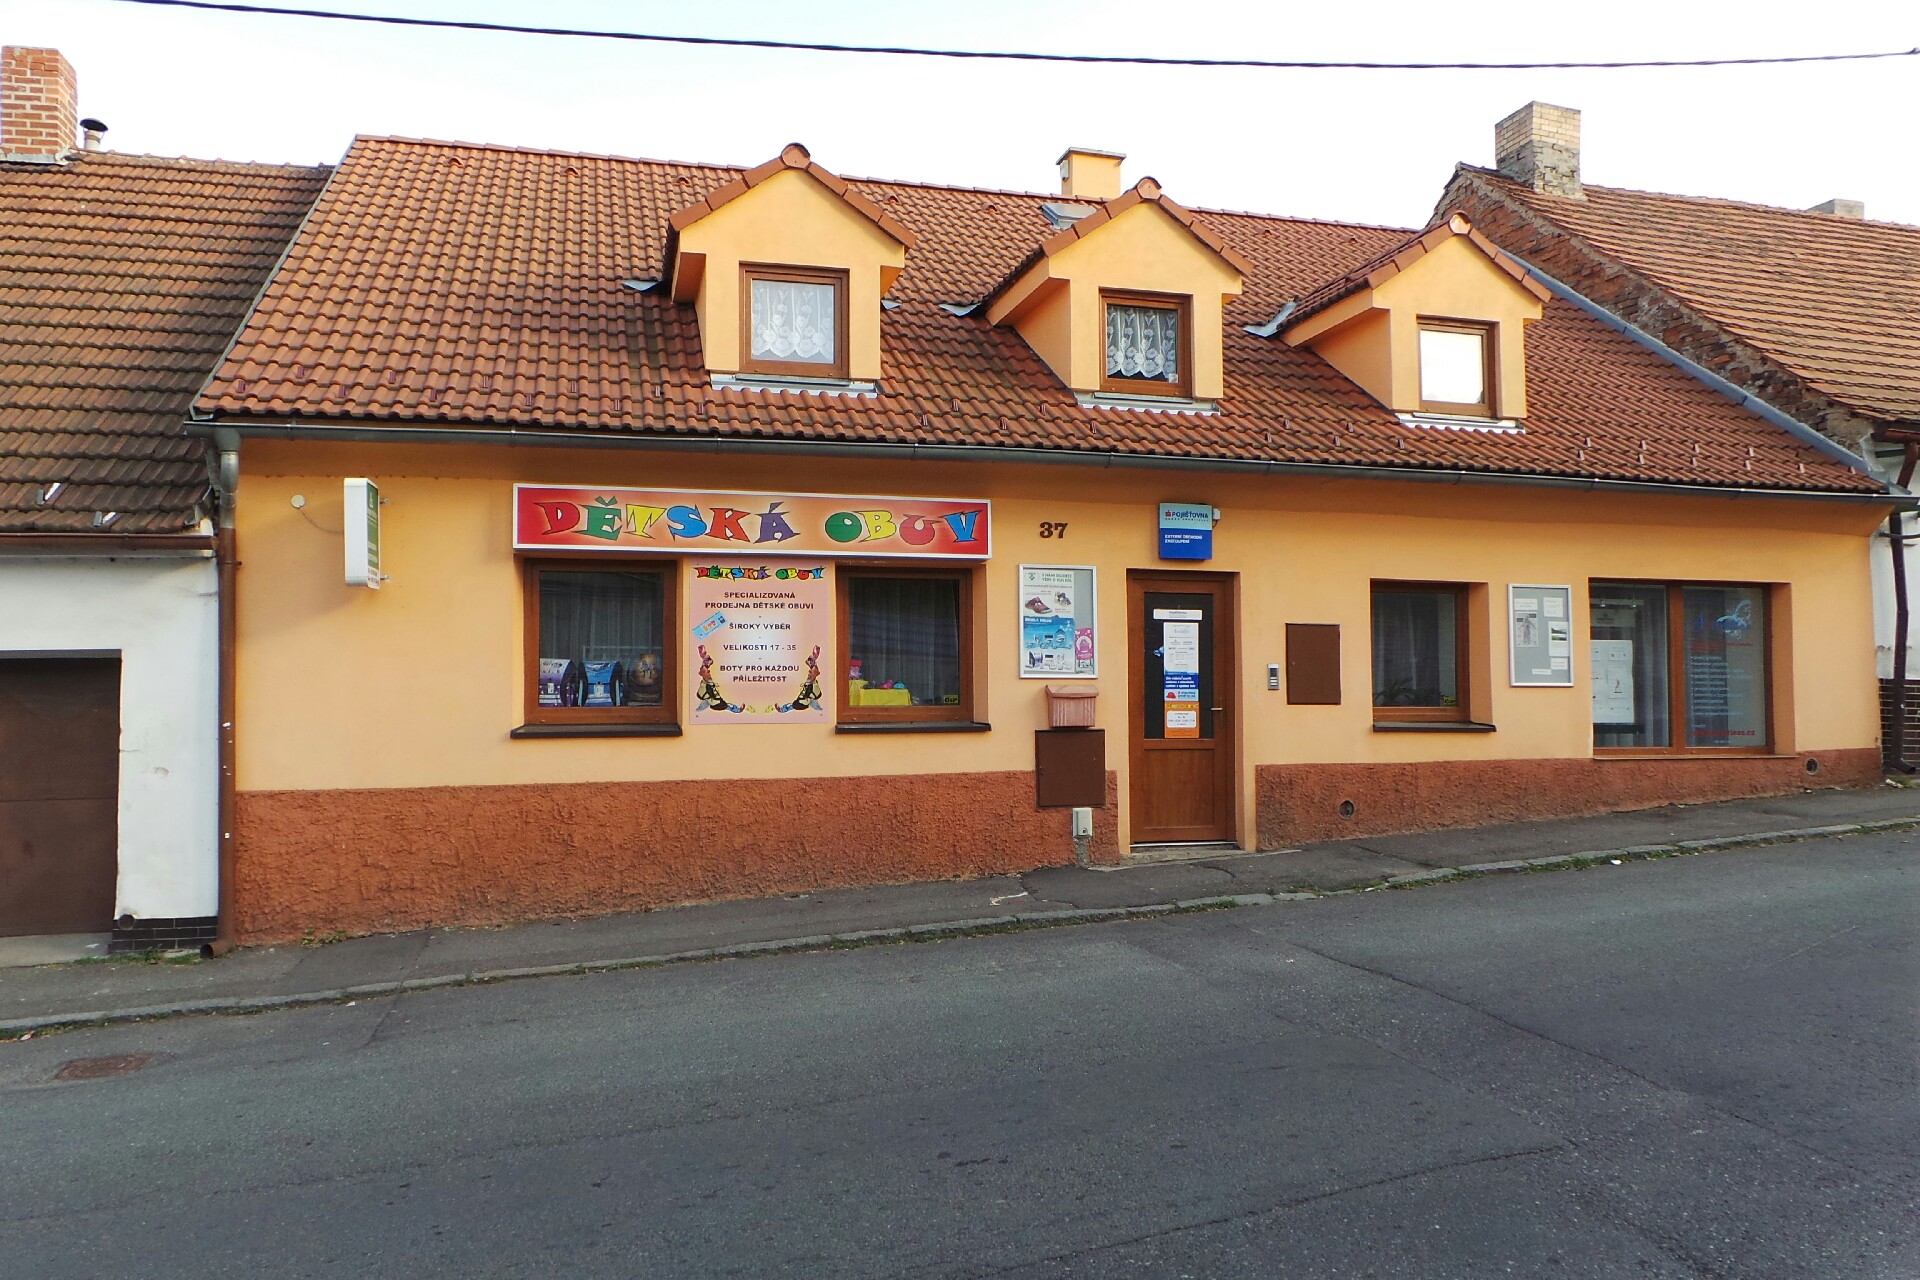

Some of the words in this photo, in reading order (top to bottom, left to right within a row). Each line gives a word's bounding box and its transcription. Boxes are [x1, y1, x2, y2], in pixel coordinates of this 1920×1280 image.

[533, 496, 801, 543] DĚTSKÁ
[825, 510, 982, 546] OBUV
[1039, 522, 1069, 539] 37
[692, 565, 772, 582] DĚTSKÁ
[775, 566, 827, 580] OBUV
[724, 591, 796, 599] SPECIALIZOVANÁ
[765, 664, 800, 672] KAŽDOU
[733, 675, 787, 683] PŘÍLEŽITOST
